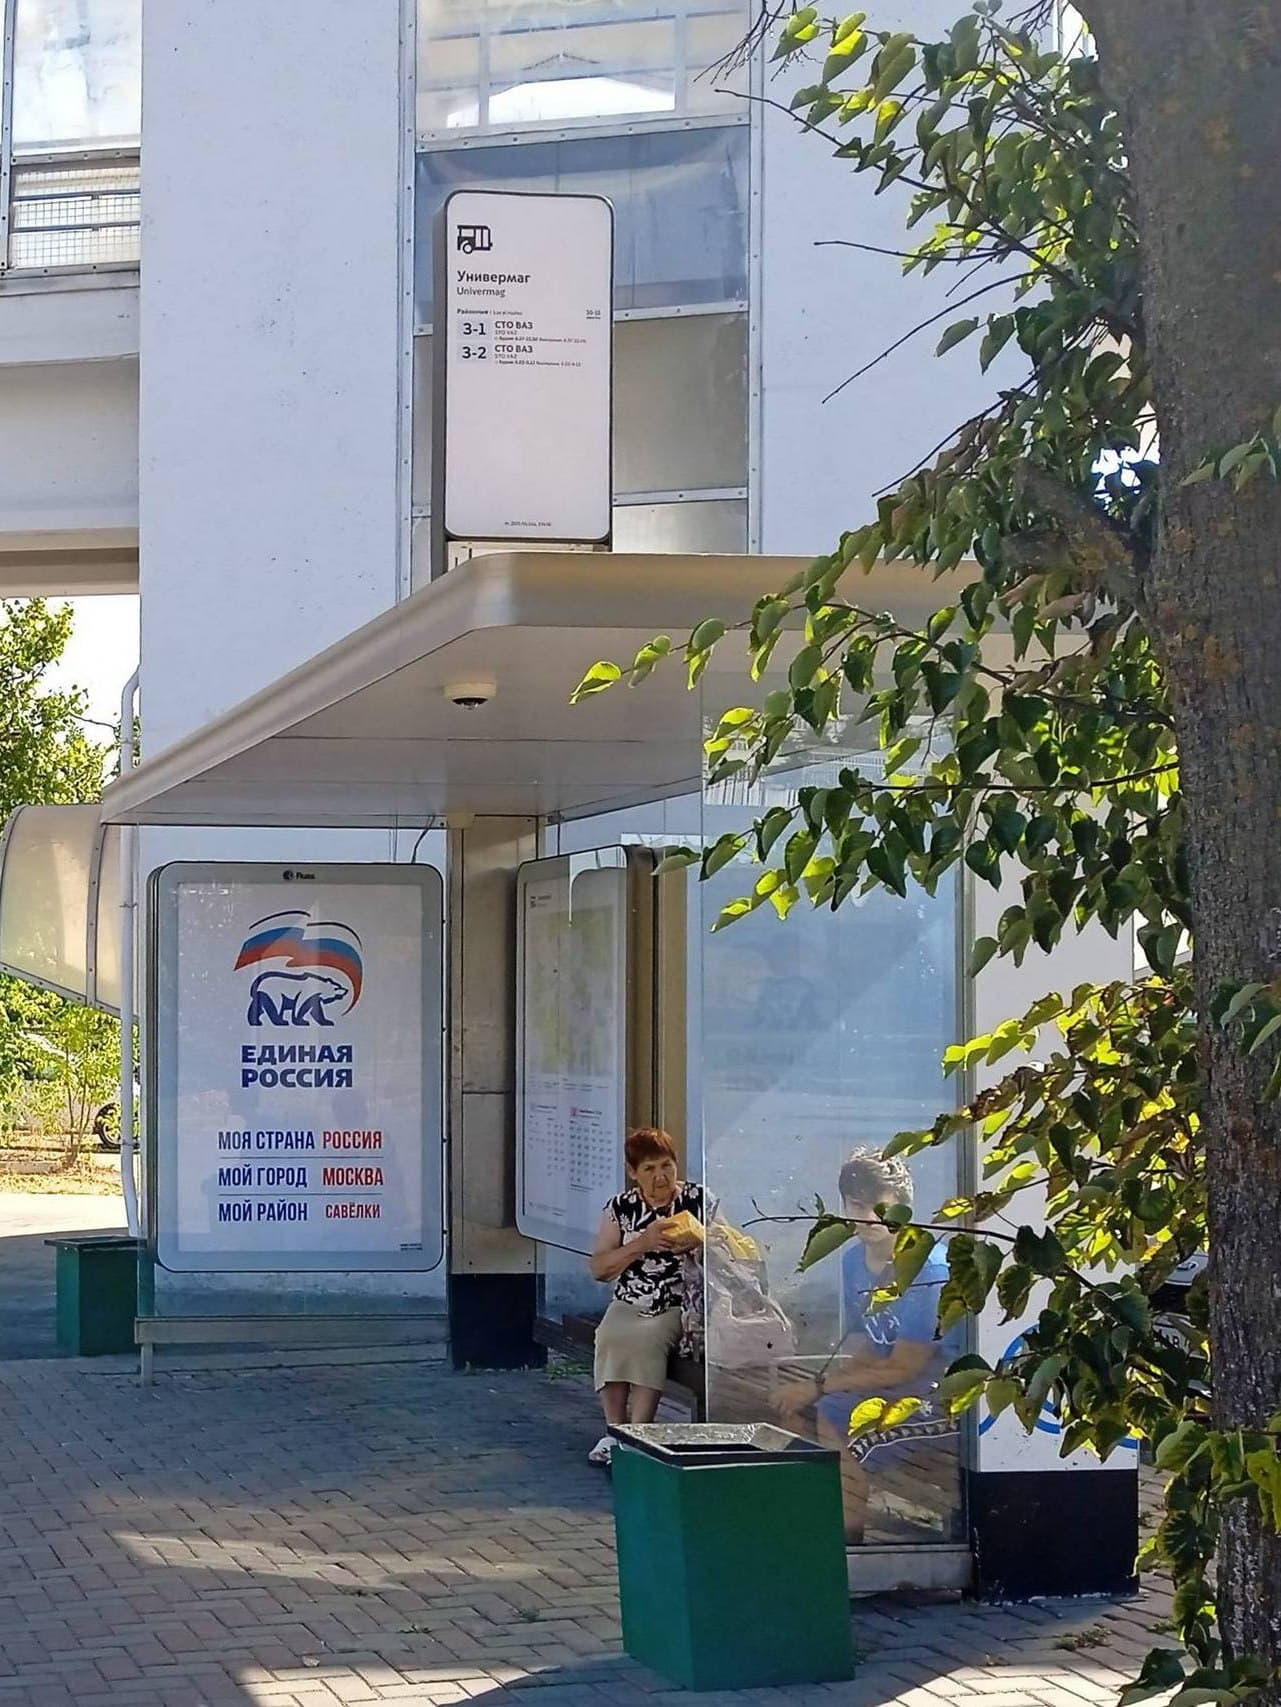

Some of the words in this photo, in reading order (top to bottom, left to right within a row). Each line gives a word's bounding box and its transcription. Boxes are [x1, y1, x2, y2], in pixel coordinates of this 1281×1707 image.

[457, 270, 531, 285] Универмаг
[456, 287, 506, 298] Univermag
[463, 322, 486, 335] 3-1
[495, 320, 514, 329] СТО
[462, 346, 487, 359] 3-2
[495, 344, 514, 353] СТО
[241, 1044, 353, 1065] ЕДИНАЯ
[241, 1068, 353, 1088] РОССИЯ
[218, 1131, 252, 1150] МОЯ
[256, 1131, 315, 1149] СТРАНА
[323, 1131, 382, 1149] РОССИЯ
[218, 1164, 252, 1187] МОЙ
[257, 1167, 308, 1188] ГОРОД
[322, 1167, 384, 1186] МОСКВА
[218, 1199, 252, 1222] МОЙ
[257, 1199, 308, 1221] РАЙОН
[325, 1202, 381, 1219] САВЁЛКИ
